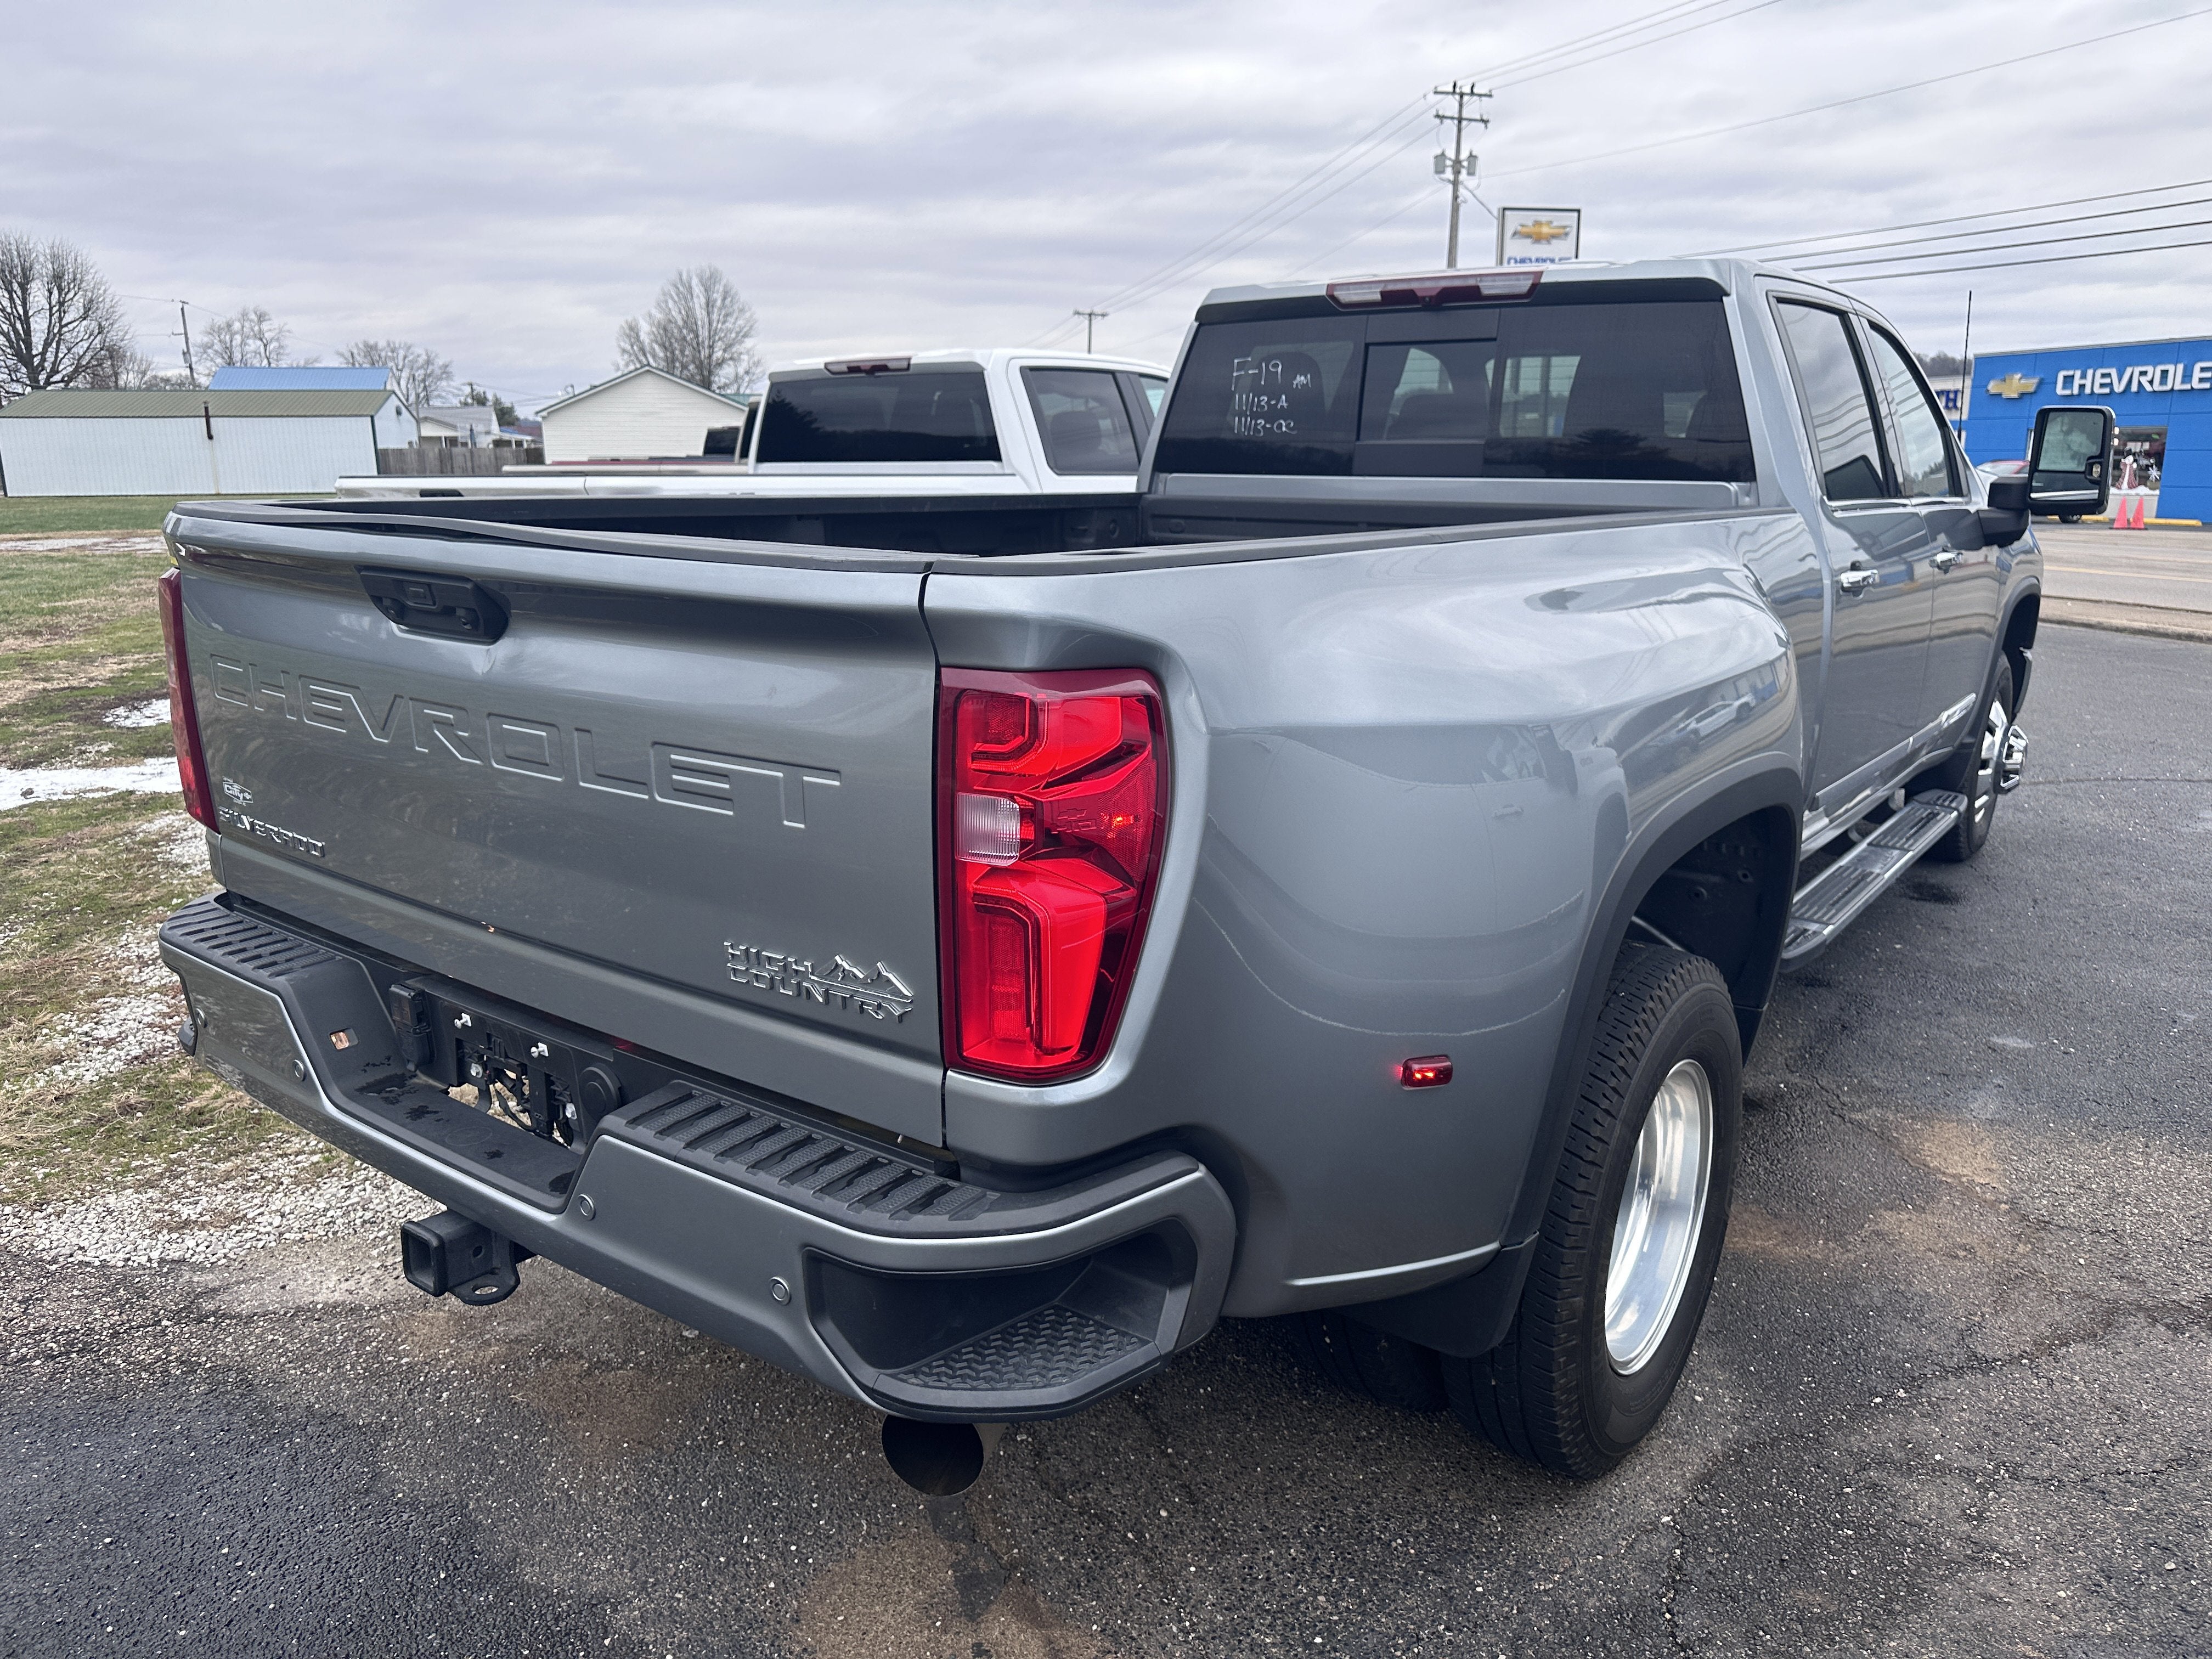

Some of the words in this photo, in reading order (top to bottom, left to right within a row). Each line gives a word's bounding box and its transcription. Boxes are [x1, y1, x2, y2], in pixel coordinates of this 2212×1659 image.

[1231, 357, 1282, 391] F-19
[210, 653, 842, 829] CHEVROLET
[218, 806, 326, 858] SILVERADO
[723, 940, 814, 980] HIGH
[726, 962, 913, 1024] COUNTRY
